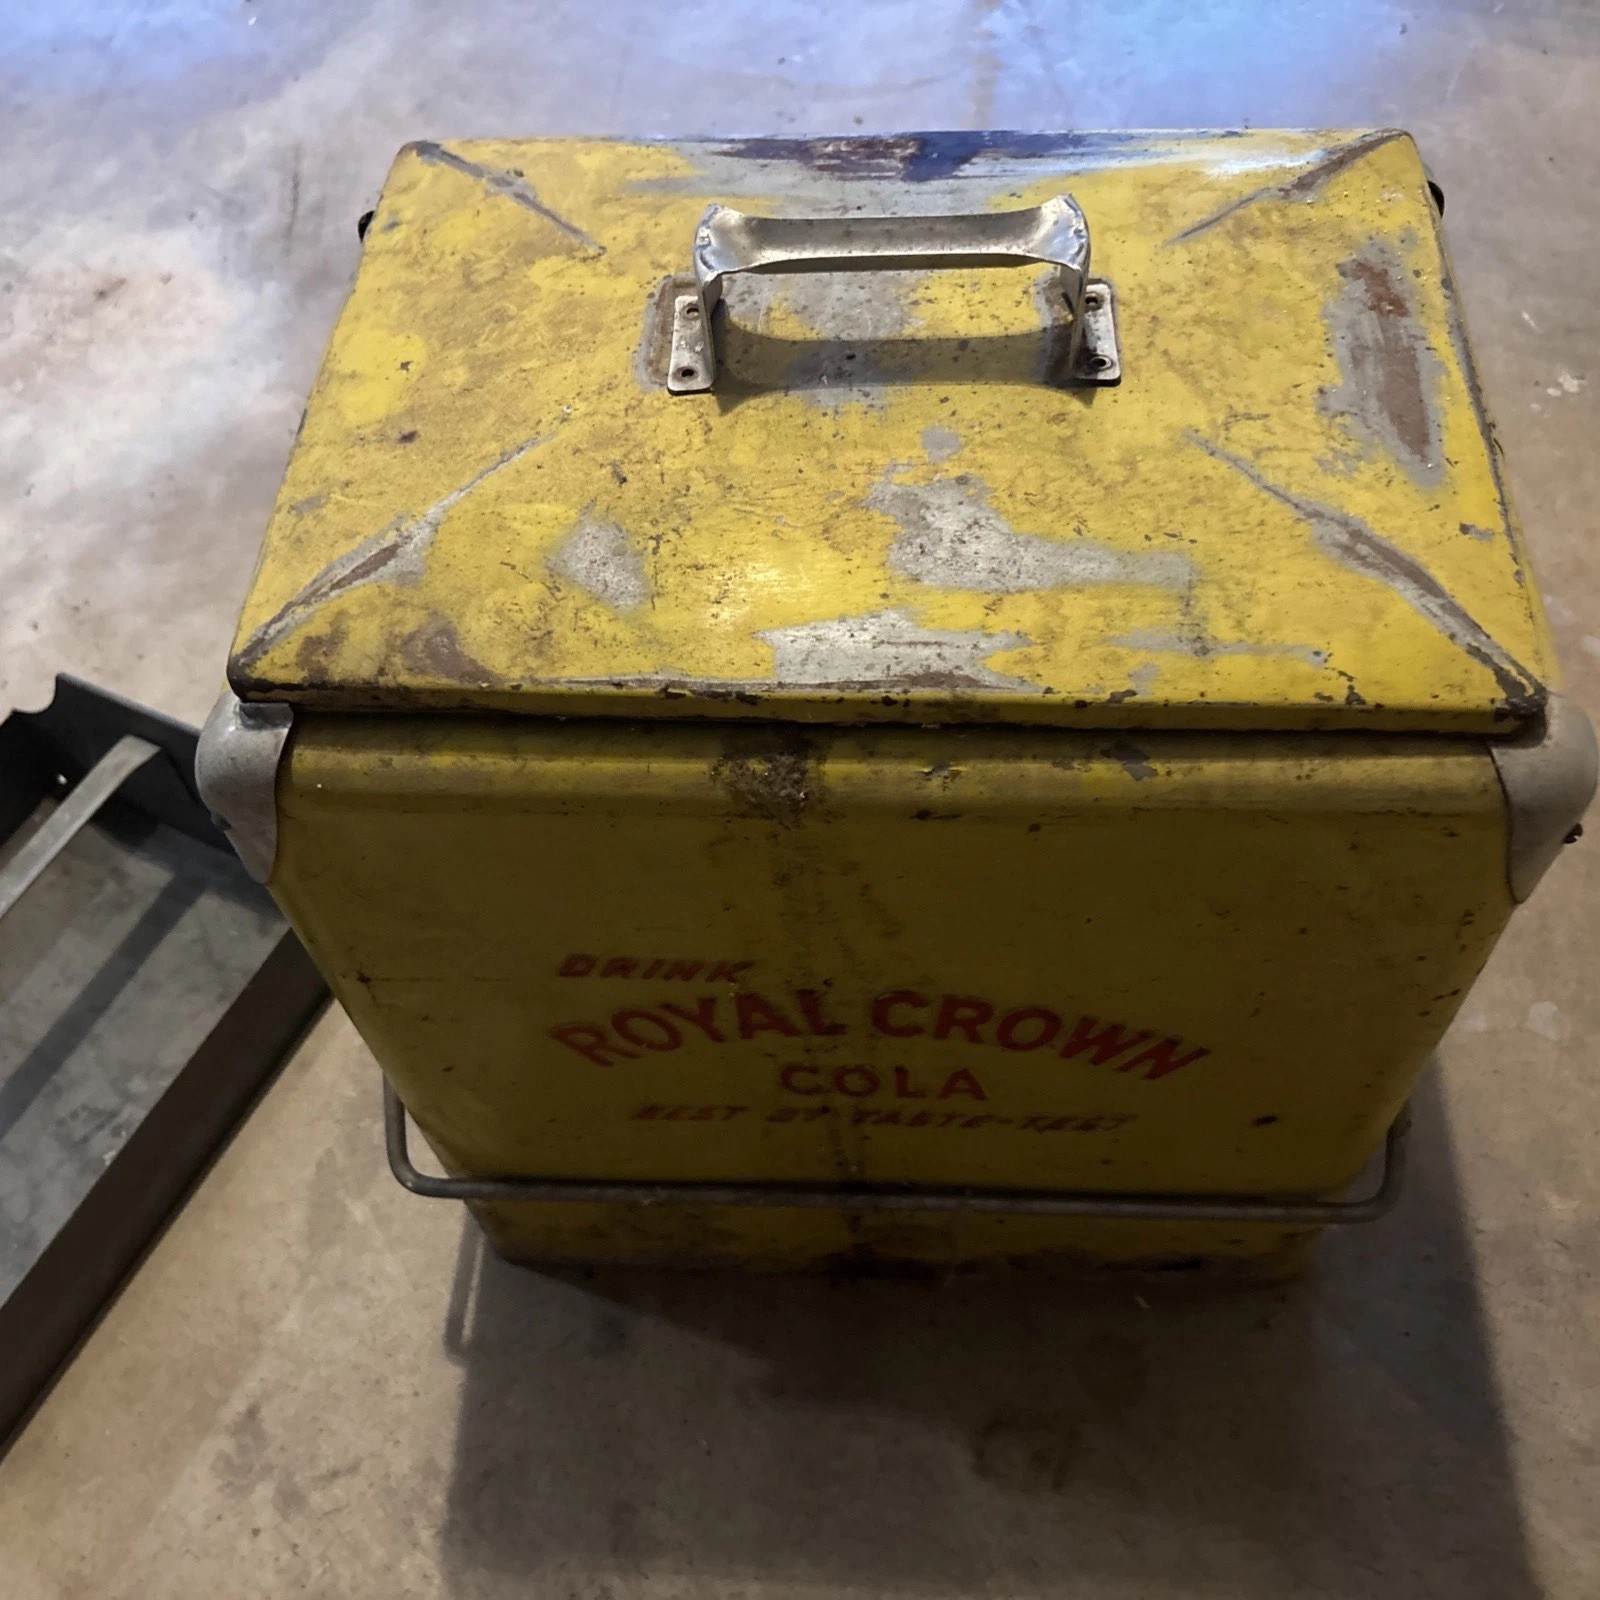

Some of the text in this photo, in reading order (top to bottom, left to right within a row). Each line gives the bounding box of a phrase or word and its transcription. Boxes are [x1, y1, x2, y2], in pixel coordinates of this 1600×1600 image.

[557, 954, 754, 983] DRINK
[551, 989, 1210, 1080] ROYAL CROWN
[782, 1066, 987, 1101] COLA
